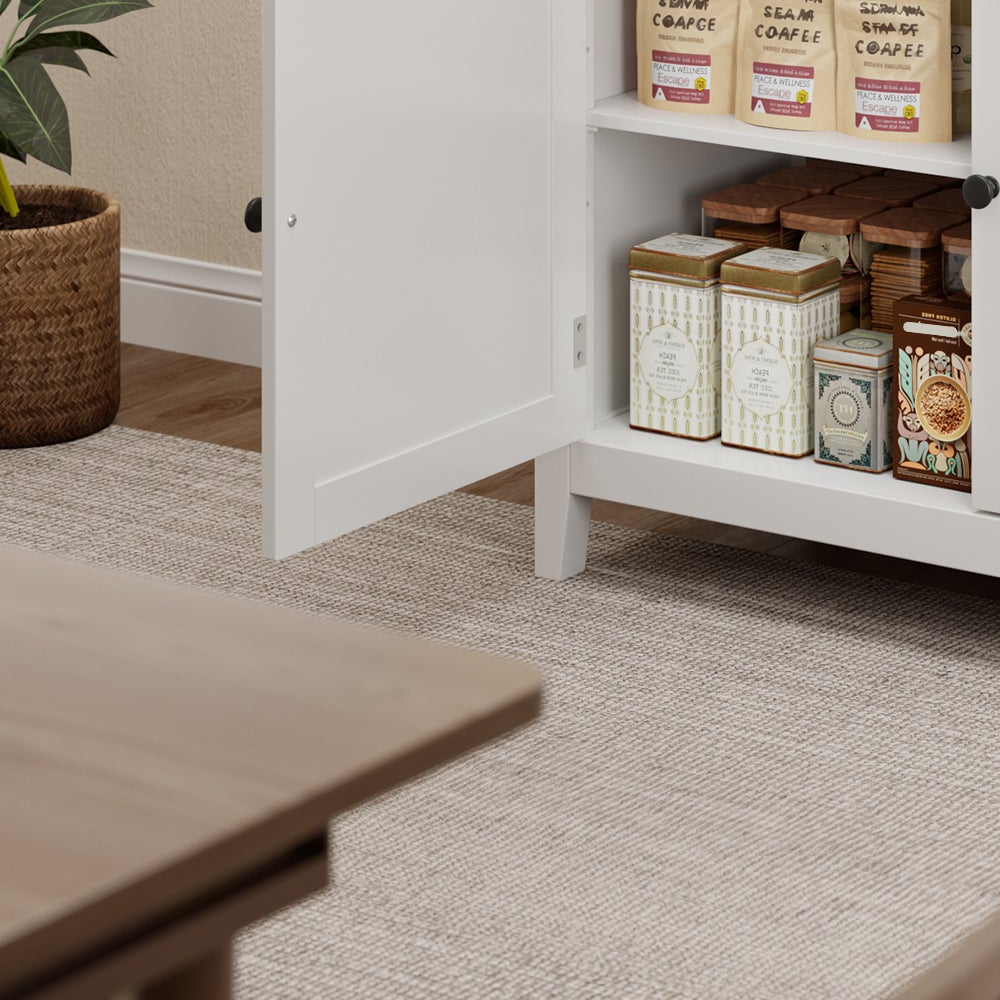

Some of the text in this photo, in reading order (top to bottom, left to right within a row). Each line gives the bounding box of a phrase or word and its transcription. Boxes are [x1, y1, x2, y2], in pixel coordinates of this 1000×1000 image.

[653, 62, 671, 72] PEACE
[677, 66, 708, 75] WELLNESS
[657, 72, 690, 87] Escape
[753, 75, 772, 84] PEACE
[779, 78, 811, 88] WELLNESS
[757, 85, 791, 100] Escape
[856, 91, 877, 100] PEACE
[884, 94, 918, 102] WELLNESS
[862, 100, 898, 115] Escape
